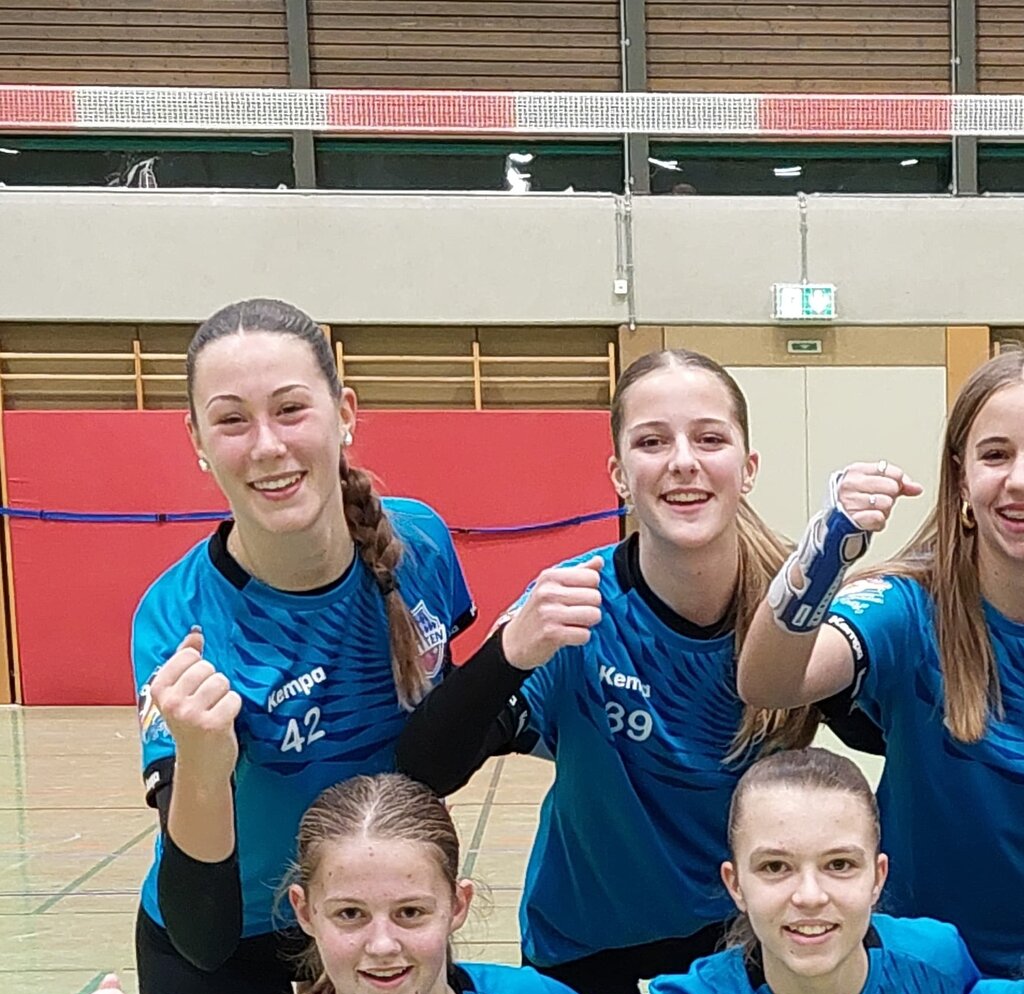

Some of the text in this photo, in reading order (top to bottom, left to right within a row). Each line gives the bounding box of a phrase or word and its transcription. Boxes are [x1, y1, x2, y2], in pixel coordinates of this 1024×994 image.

[267, 666, 327, 713] Kempa
[280, 706, 326, 753] 42
[605, 700, 653, 742] 39
